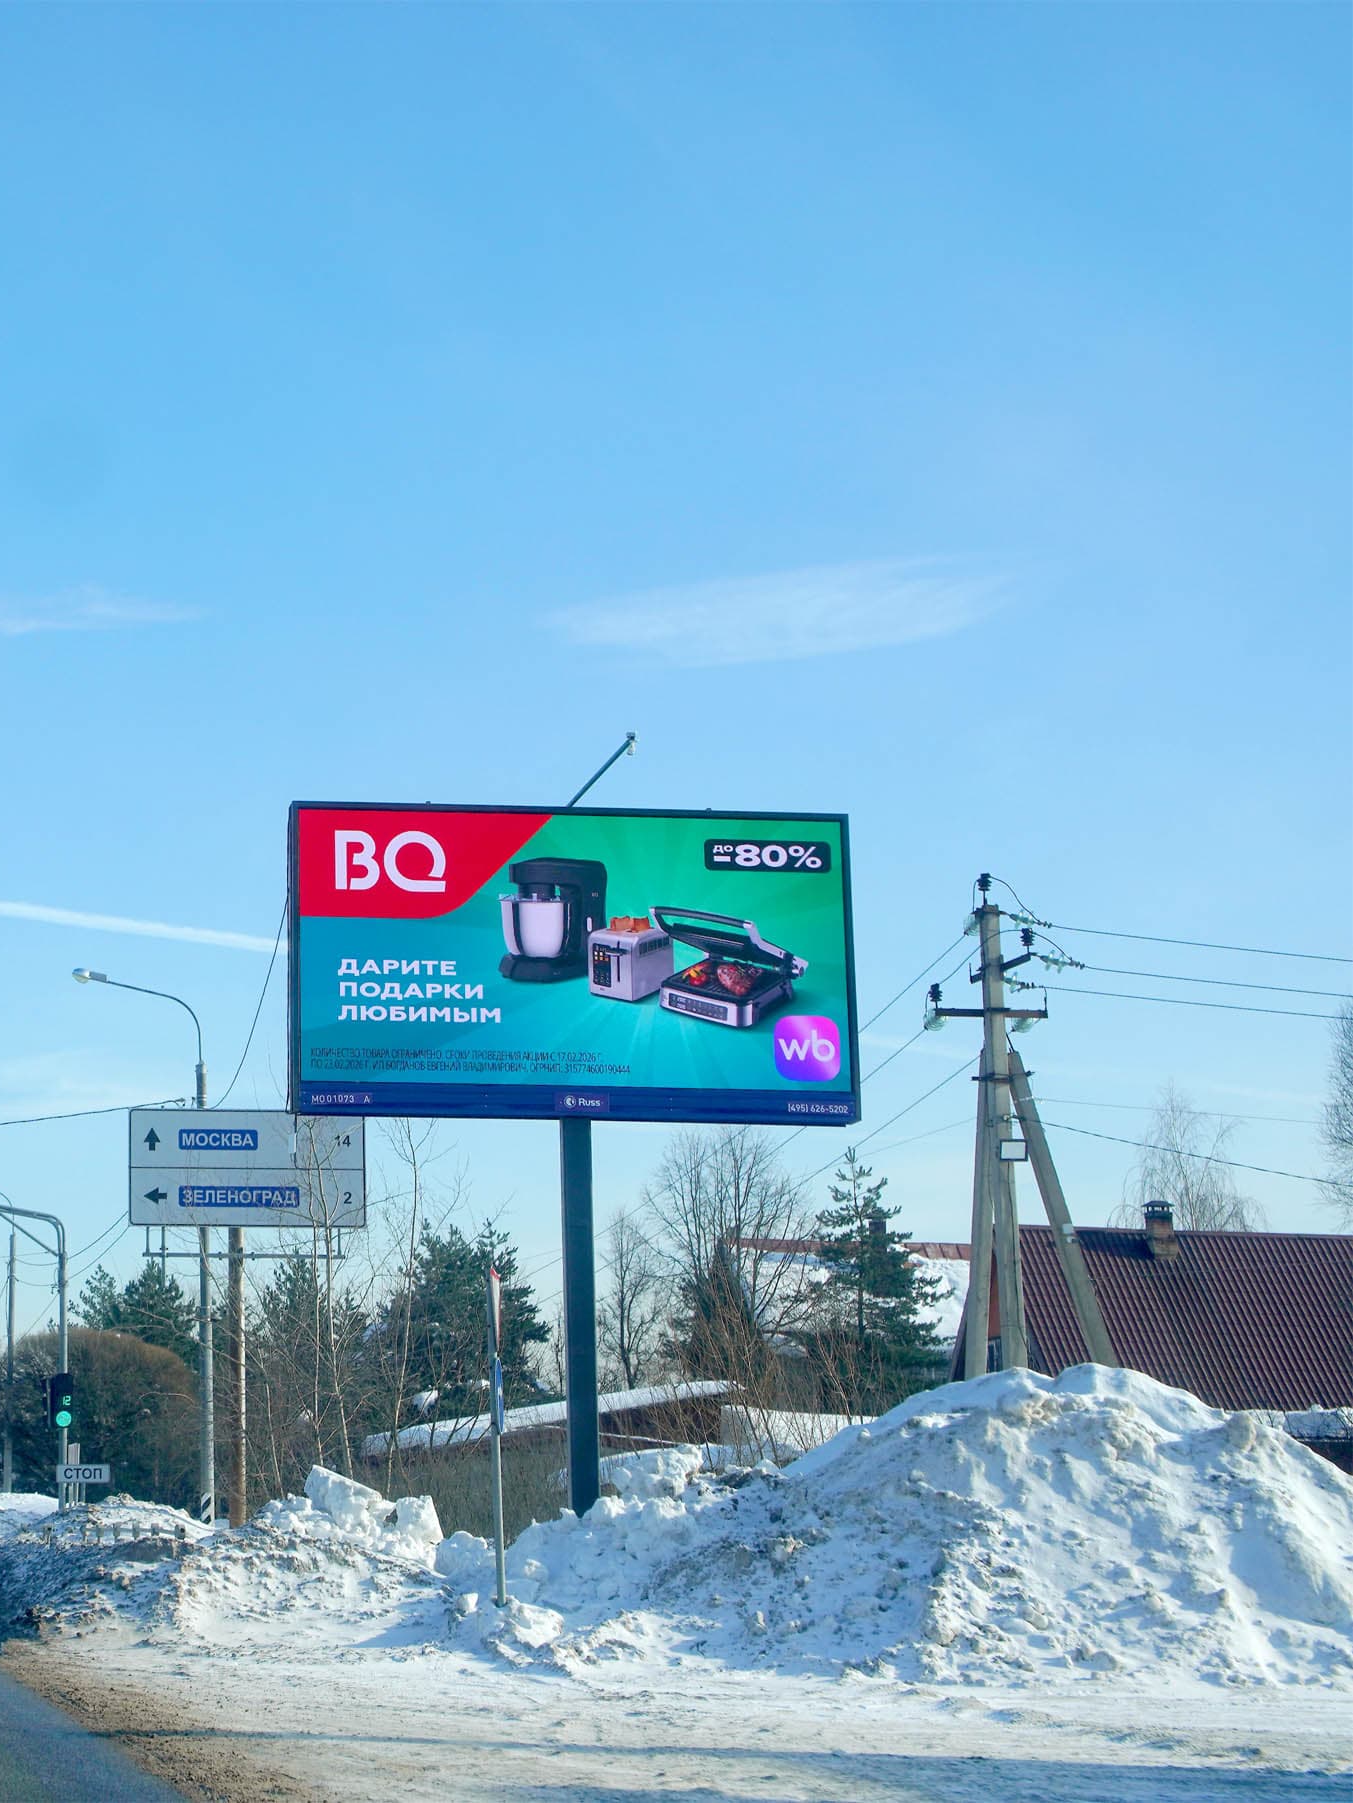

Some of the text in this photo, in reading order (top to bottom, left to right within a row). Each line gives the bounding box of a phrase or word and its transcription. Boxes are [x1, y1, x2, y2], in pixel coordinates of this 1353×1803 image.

[334, 829, 446, 892] BQ
[337, 958, 457, 977] ДАРИТЕ
[339, 981, 484, 1001] ПОДАРКИ
[337, 1004, 502, 1024] ЛЮБИМЫМ
[777, 1029, 836, 1063] wb
[578, 1098, 601, 1107] Russ
[788, 1103, 809, 1113] (495)
[181, 1133, 351, 1147] МОСКВА 14
[181, 1189, 353, 1206] ЗЕЛЕНОГРАД 2
[62, 1395, 71, 1406] 12
[63, 1468, 103, 1480] СТОП
